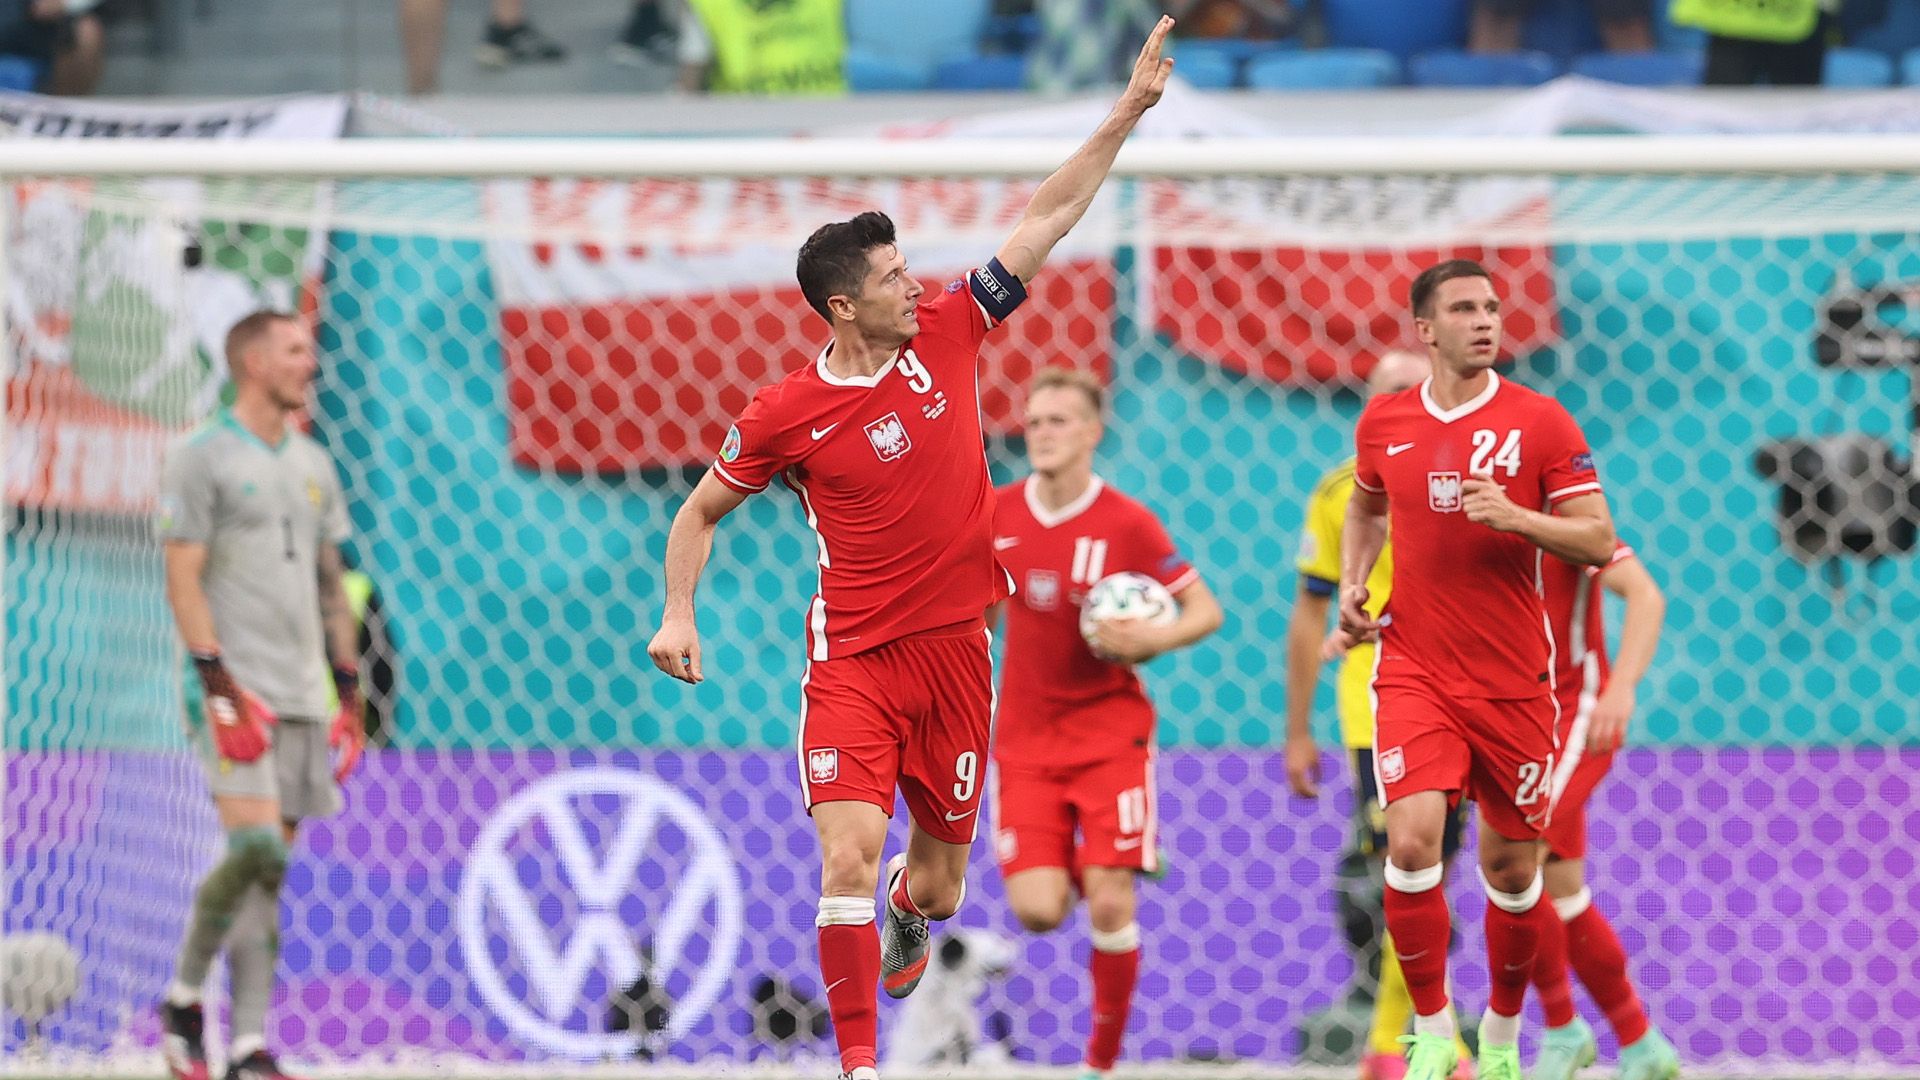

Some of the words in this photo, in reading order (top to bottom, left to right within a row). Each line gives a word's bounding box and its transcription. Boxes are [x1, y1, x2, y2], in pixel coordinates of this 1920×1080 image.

[896, 348, 933, 394] 9
[1468, 429, 1522, 478] 24
[1071, 536, 1108, 585] 11
[953, 751, 978, 802] 9
[1117, 786, 1147, 835] 11
